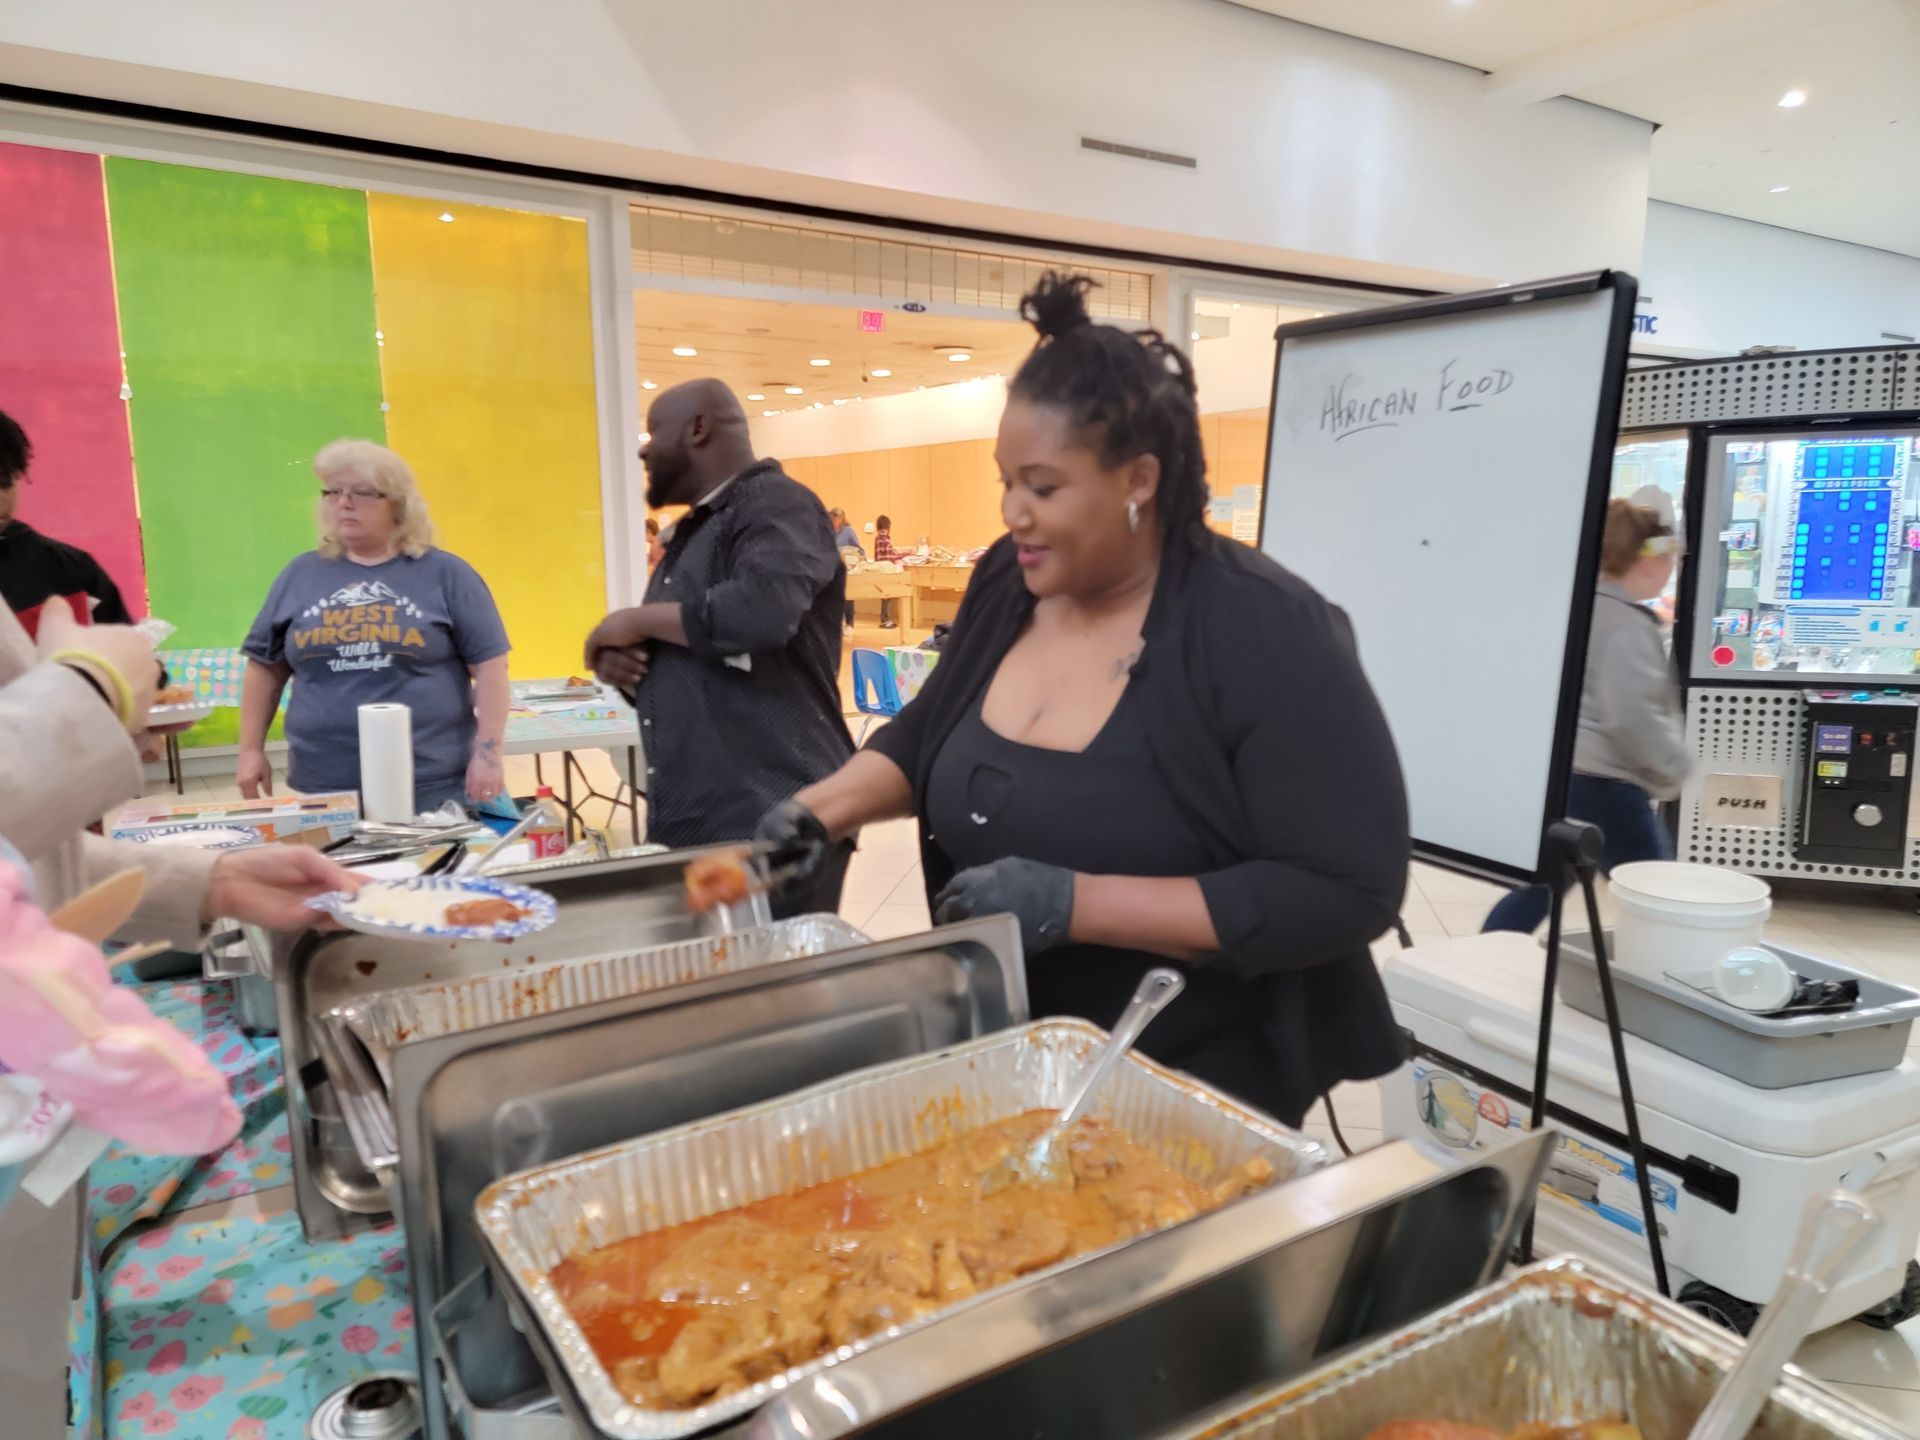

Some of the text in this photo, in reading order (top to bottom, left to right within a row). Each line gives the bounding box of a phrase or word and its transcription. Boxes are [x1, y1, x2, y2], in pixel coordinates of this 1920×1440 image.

[1319, 374, 1418, 434] AFRICAN
[322, 604, 397, 626] WEST
[294, 623, 426, 650] VIRGINIA
[325, 653, 393, 673] Wonderful
[1717, 796, 1767, 810] PUSH
[320, 811, 356, 824] PIECES
